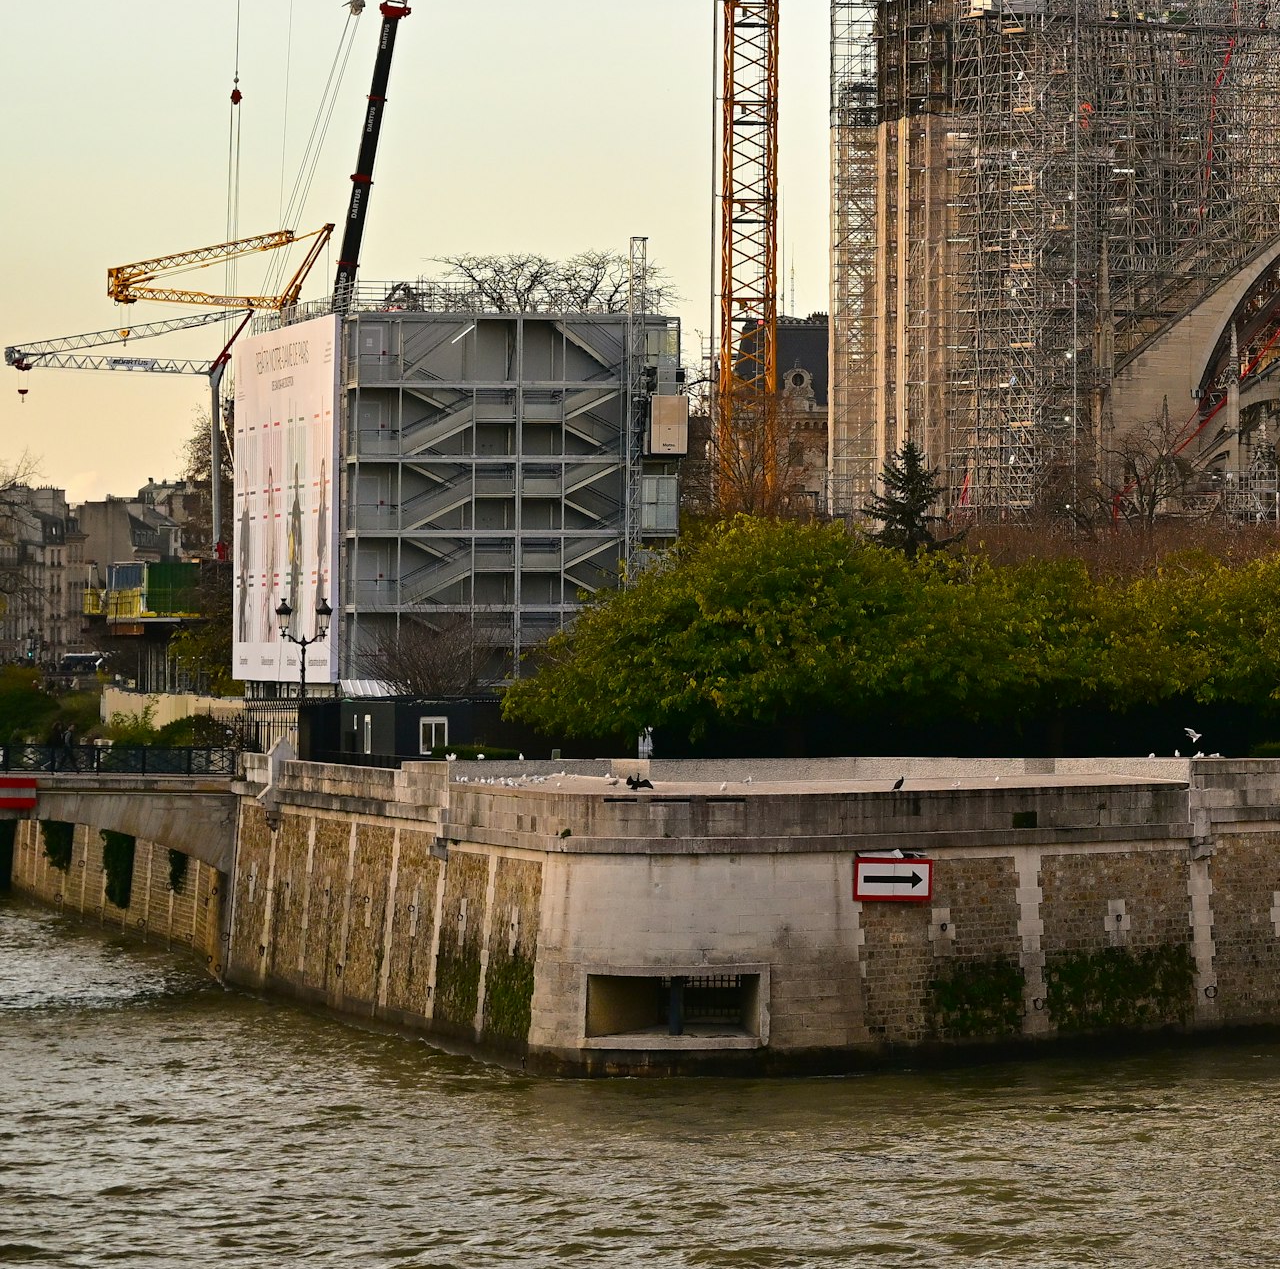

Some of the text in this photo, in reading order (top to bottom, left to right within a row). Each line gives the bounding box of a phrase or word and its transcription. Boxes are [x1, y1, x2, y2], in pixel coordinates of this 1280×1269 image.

[381, 23, 391, 50] DARTUS
[366, 106, 376, 133] DARTUS
[350, 188, 362, 219] DARTUS
[119, 358, 149, 366] DARTUS
